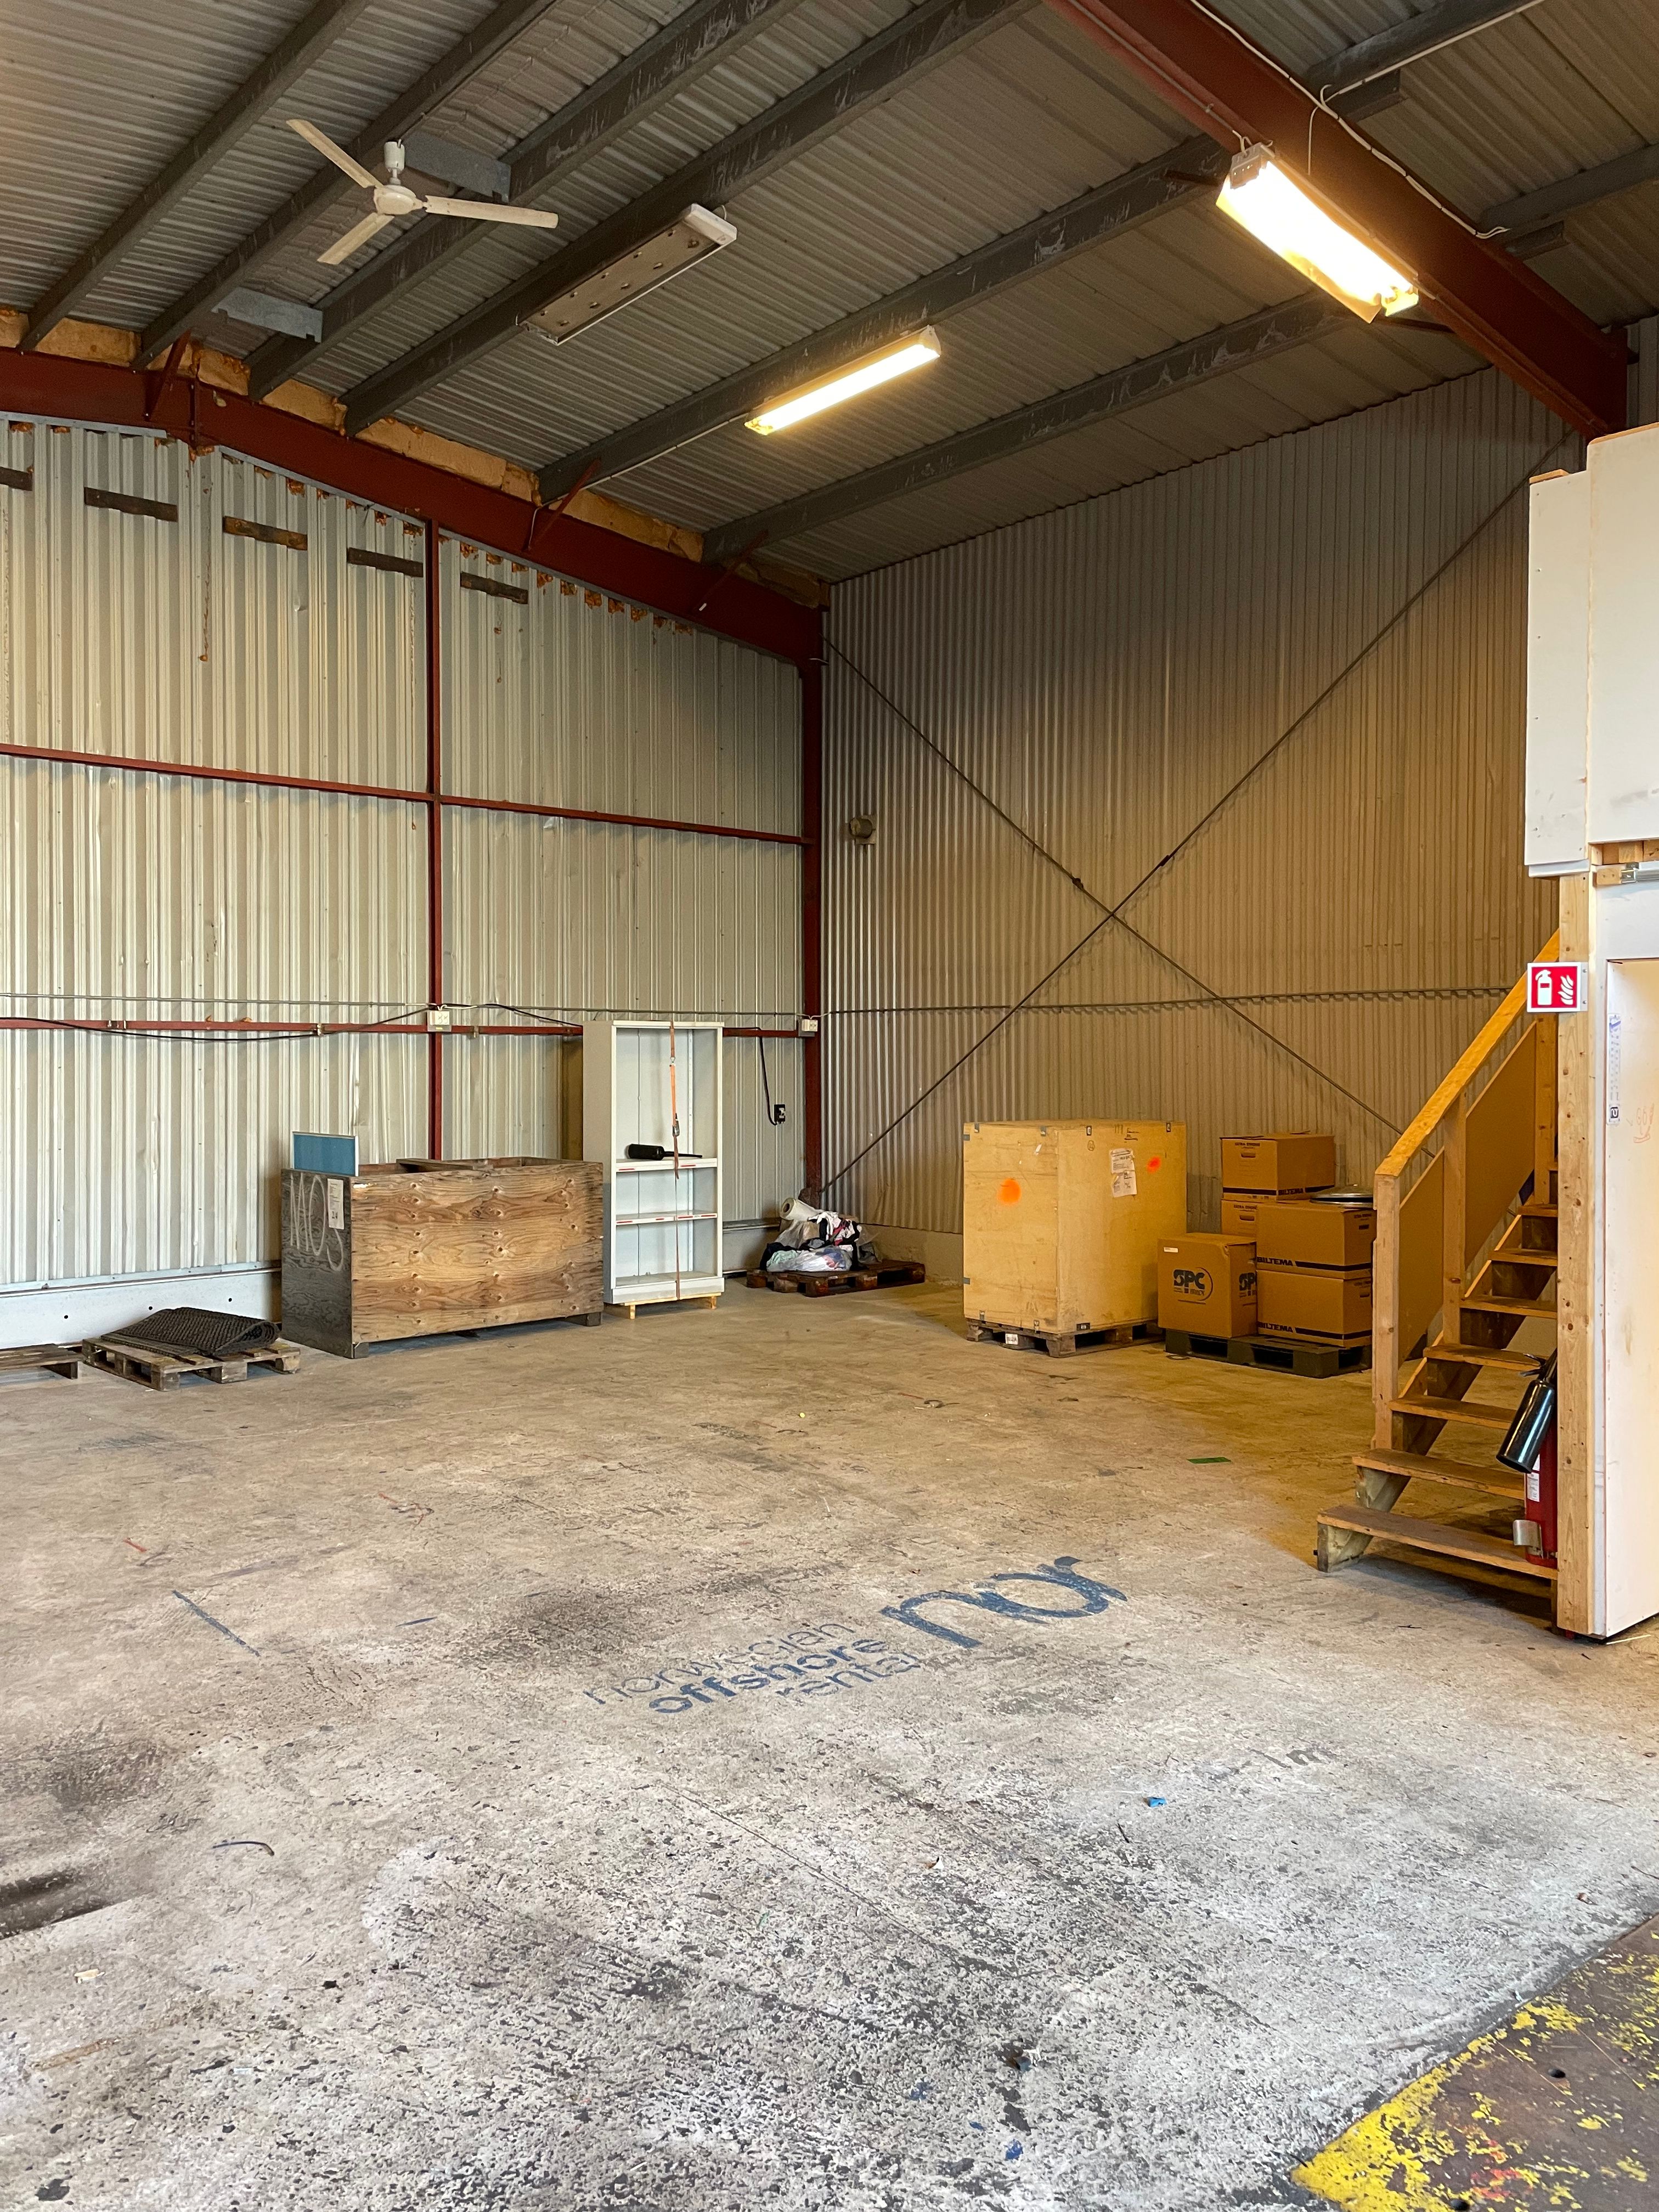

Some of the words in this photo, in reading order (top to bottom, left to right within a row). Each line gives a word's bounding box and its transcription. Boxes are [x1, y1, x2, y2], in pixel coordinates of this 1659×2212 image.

[1278, 1188, 1304, 1196] BILTEMA
[1257, 1256, 1294, 1266] BILTEMA
[1173, 1269, 1206, 1290] SPC
[1239, 1272, 1256, 1291] SP
[1257, 1321, 1294, 1333] BILTEMA
[648, 1639, 888, 1713] offshore
